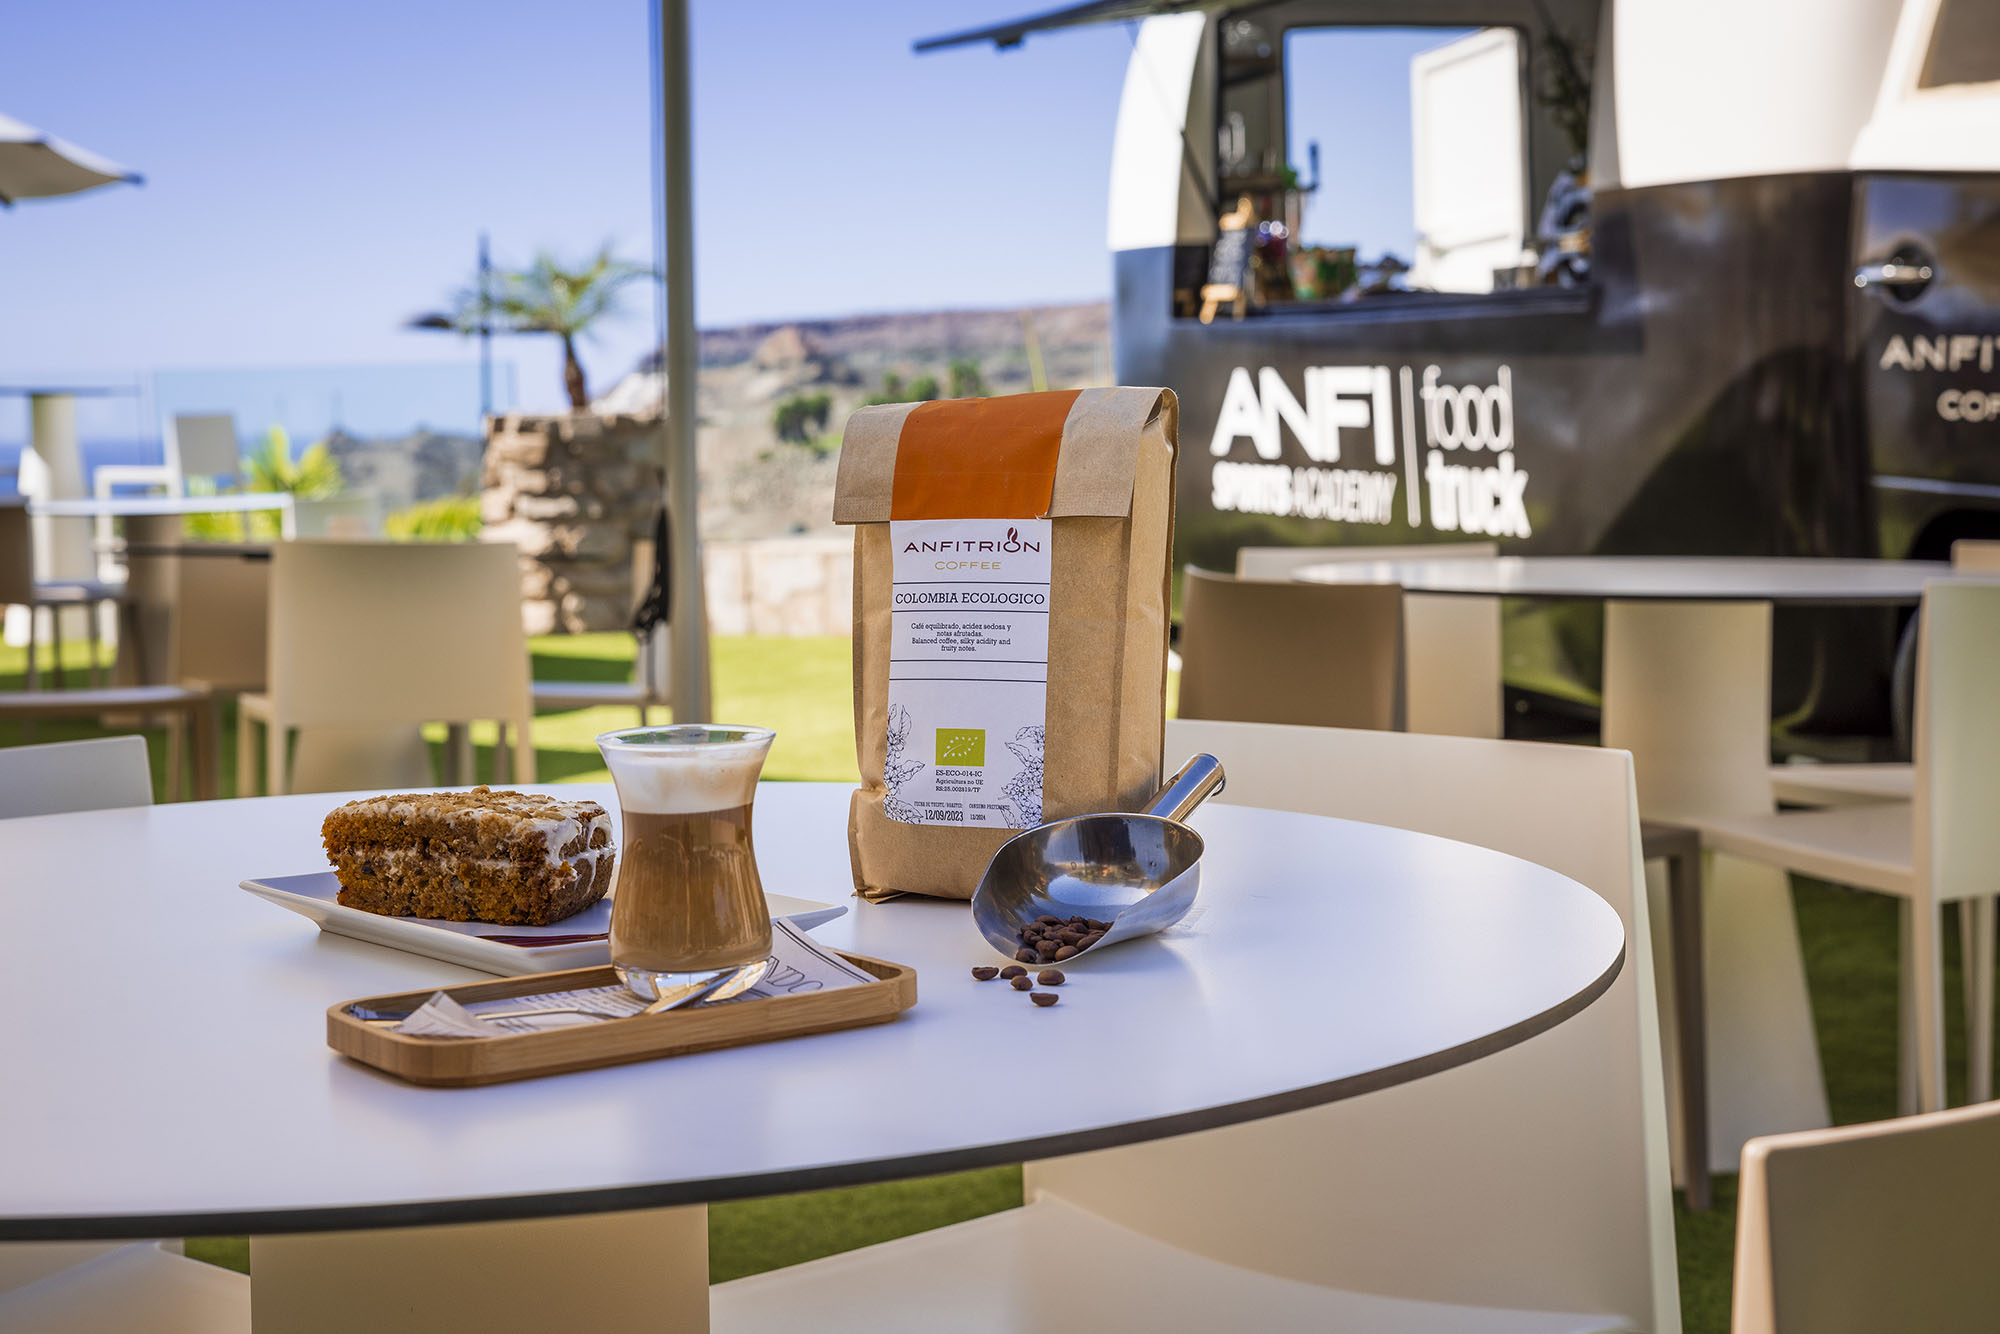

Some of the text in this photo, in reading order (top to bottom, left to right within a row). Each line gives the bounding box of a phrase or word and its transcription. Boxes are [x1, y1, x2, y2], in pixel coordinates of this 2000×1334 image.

[1879, 334, 2000, 373] ANFI
[1209, 365, 1396, 466] ANFI
[1420, 364, 1515, 451] food
[1291, 466, 1397, 525] ACADEMY
[1425, 450, 1532, 539] truck
[935, 561, 1000, 570] COFFEE
[895, 593, 1045, 604] COLOMBIA ECOLOGICO
[925, 623, 961, 631] equilibrado,
[938, 637, 959, 645] coffee,
[976, 638, 998, 646] acidity
[924, 809, 964, 822] 12/09/2023
